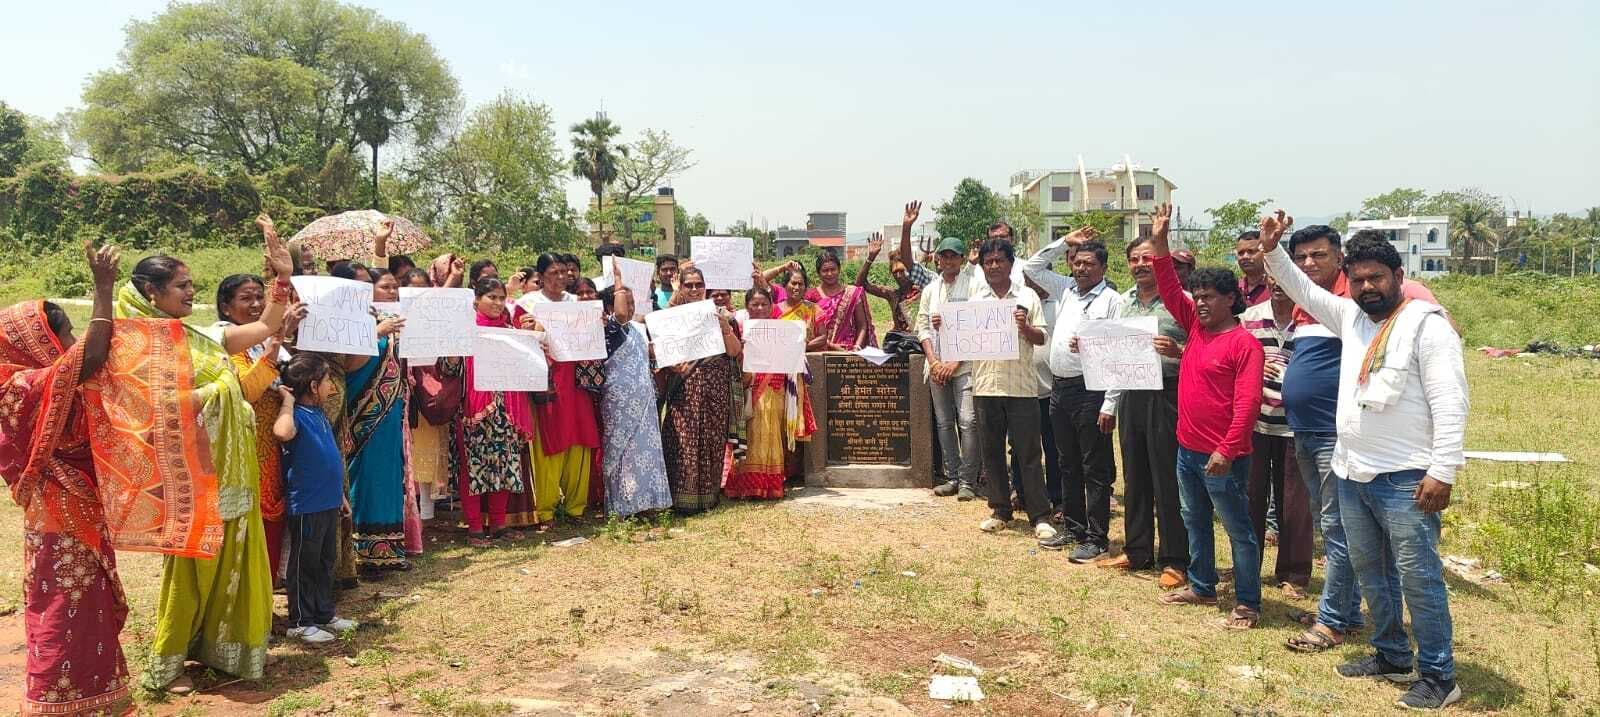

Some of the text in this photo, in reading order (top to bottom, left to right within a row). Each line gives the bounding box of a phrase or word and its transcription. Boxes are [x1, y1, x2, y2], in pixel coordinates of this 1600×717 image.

[943, 303, 1015, 331] WE WANT
[301, 313, 375, 347] HOSPITAL
[946, 331, 1016, 354] HOSPITAL
[840, 384, 897, 395] श्री हेमंत सोरेन
